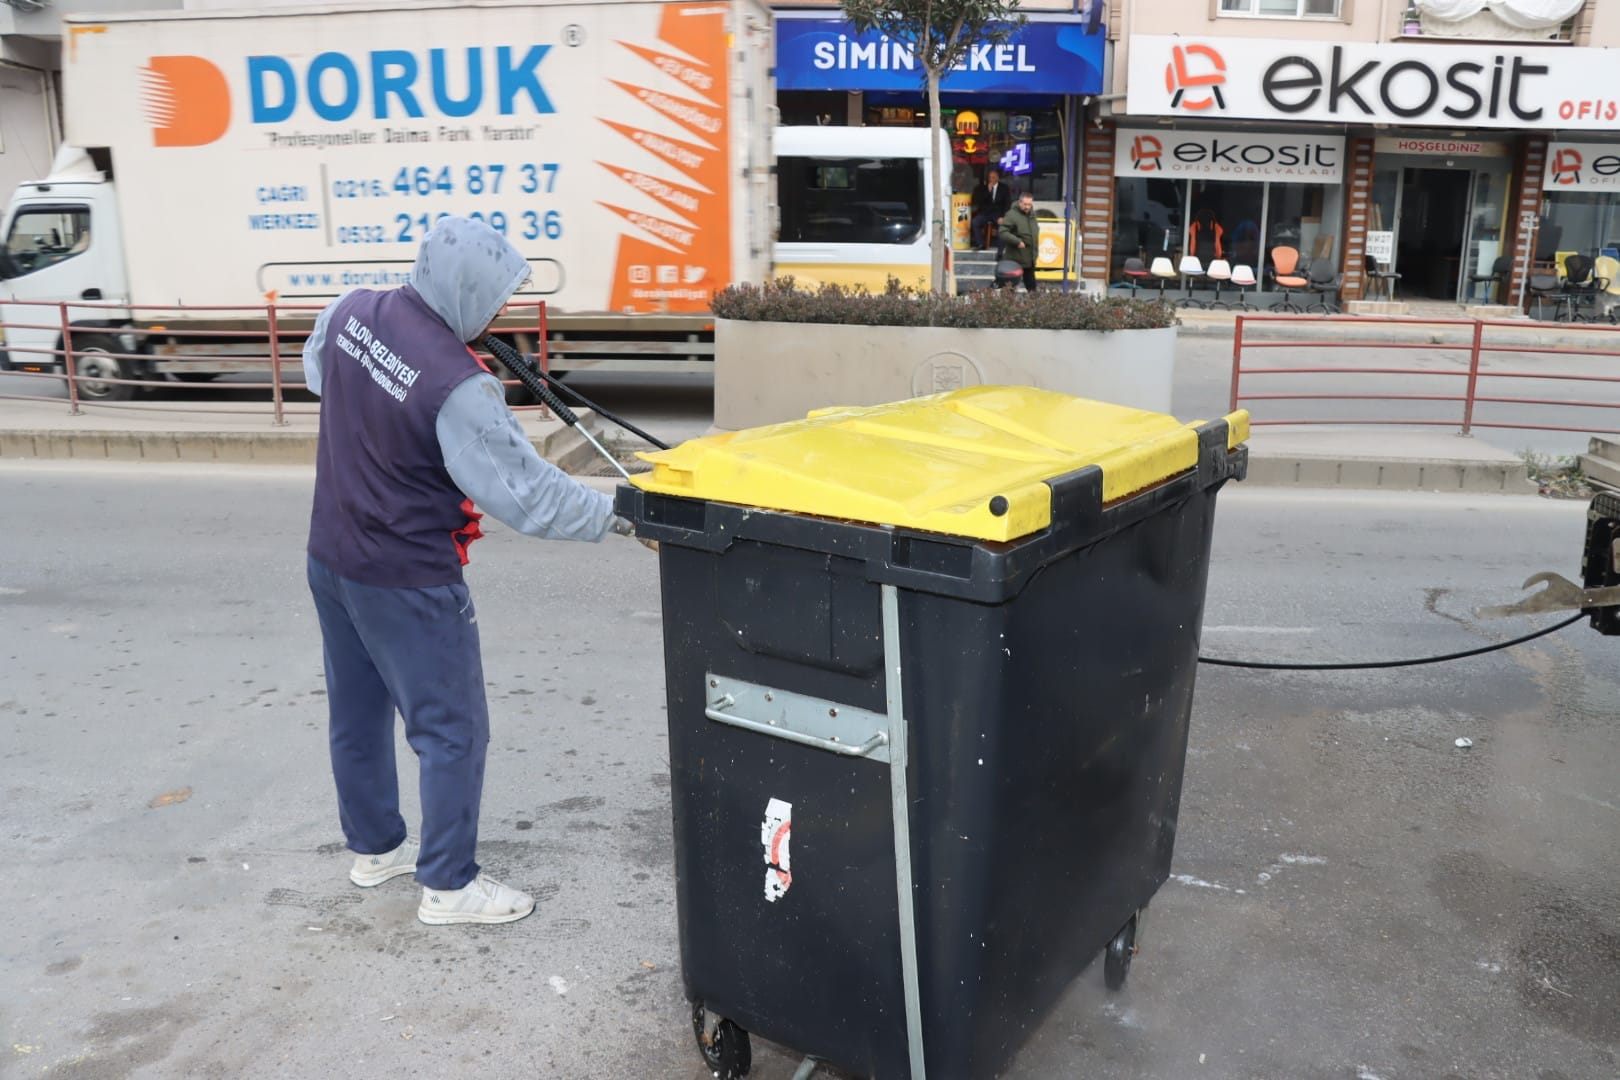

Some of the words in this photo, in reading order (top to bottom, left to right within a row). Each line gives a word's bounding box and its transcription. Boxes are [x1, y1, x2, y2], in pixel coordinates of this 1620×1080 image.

[814, 35, 914, 71] SİMİN
[931, 43, 1036, 72] EKEL
[246, 45, 556, 124] DORUK
[1262, 46, 1549, 121] ekosit
[384, 127, 431, 143] Daima
[438, 126, 471, 141] Fark
[1000, 143, 1031, 173] +1
[1174, 139, 1336, 167] ekosit
[466, 165, 505, 195] 87
[520, 163, 561, 194] 37
[470, 211, 507, 238] 9
[521, 210, 563, 240] 36
[369, 339, 421, 388] BELEDİYESİ
